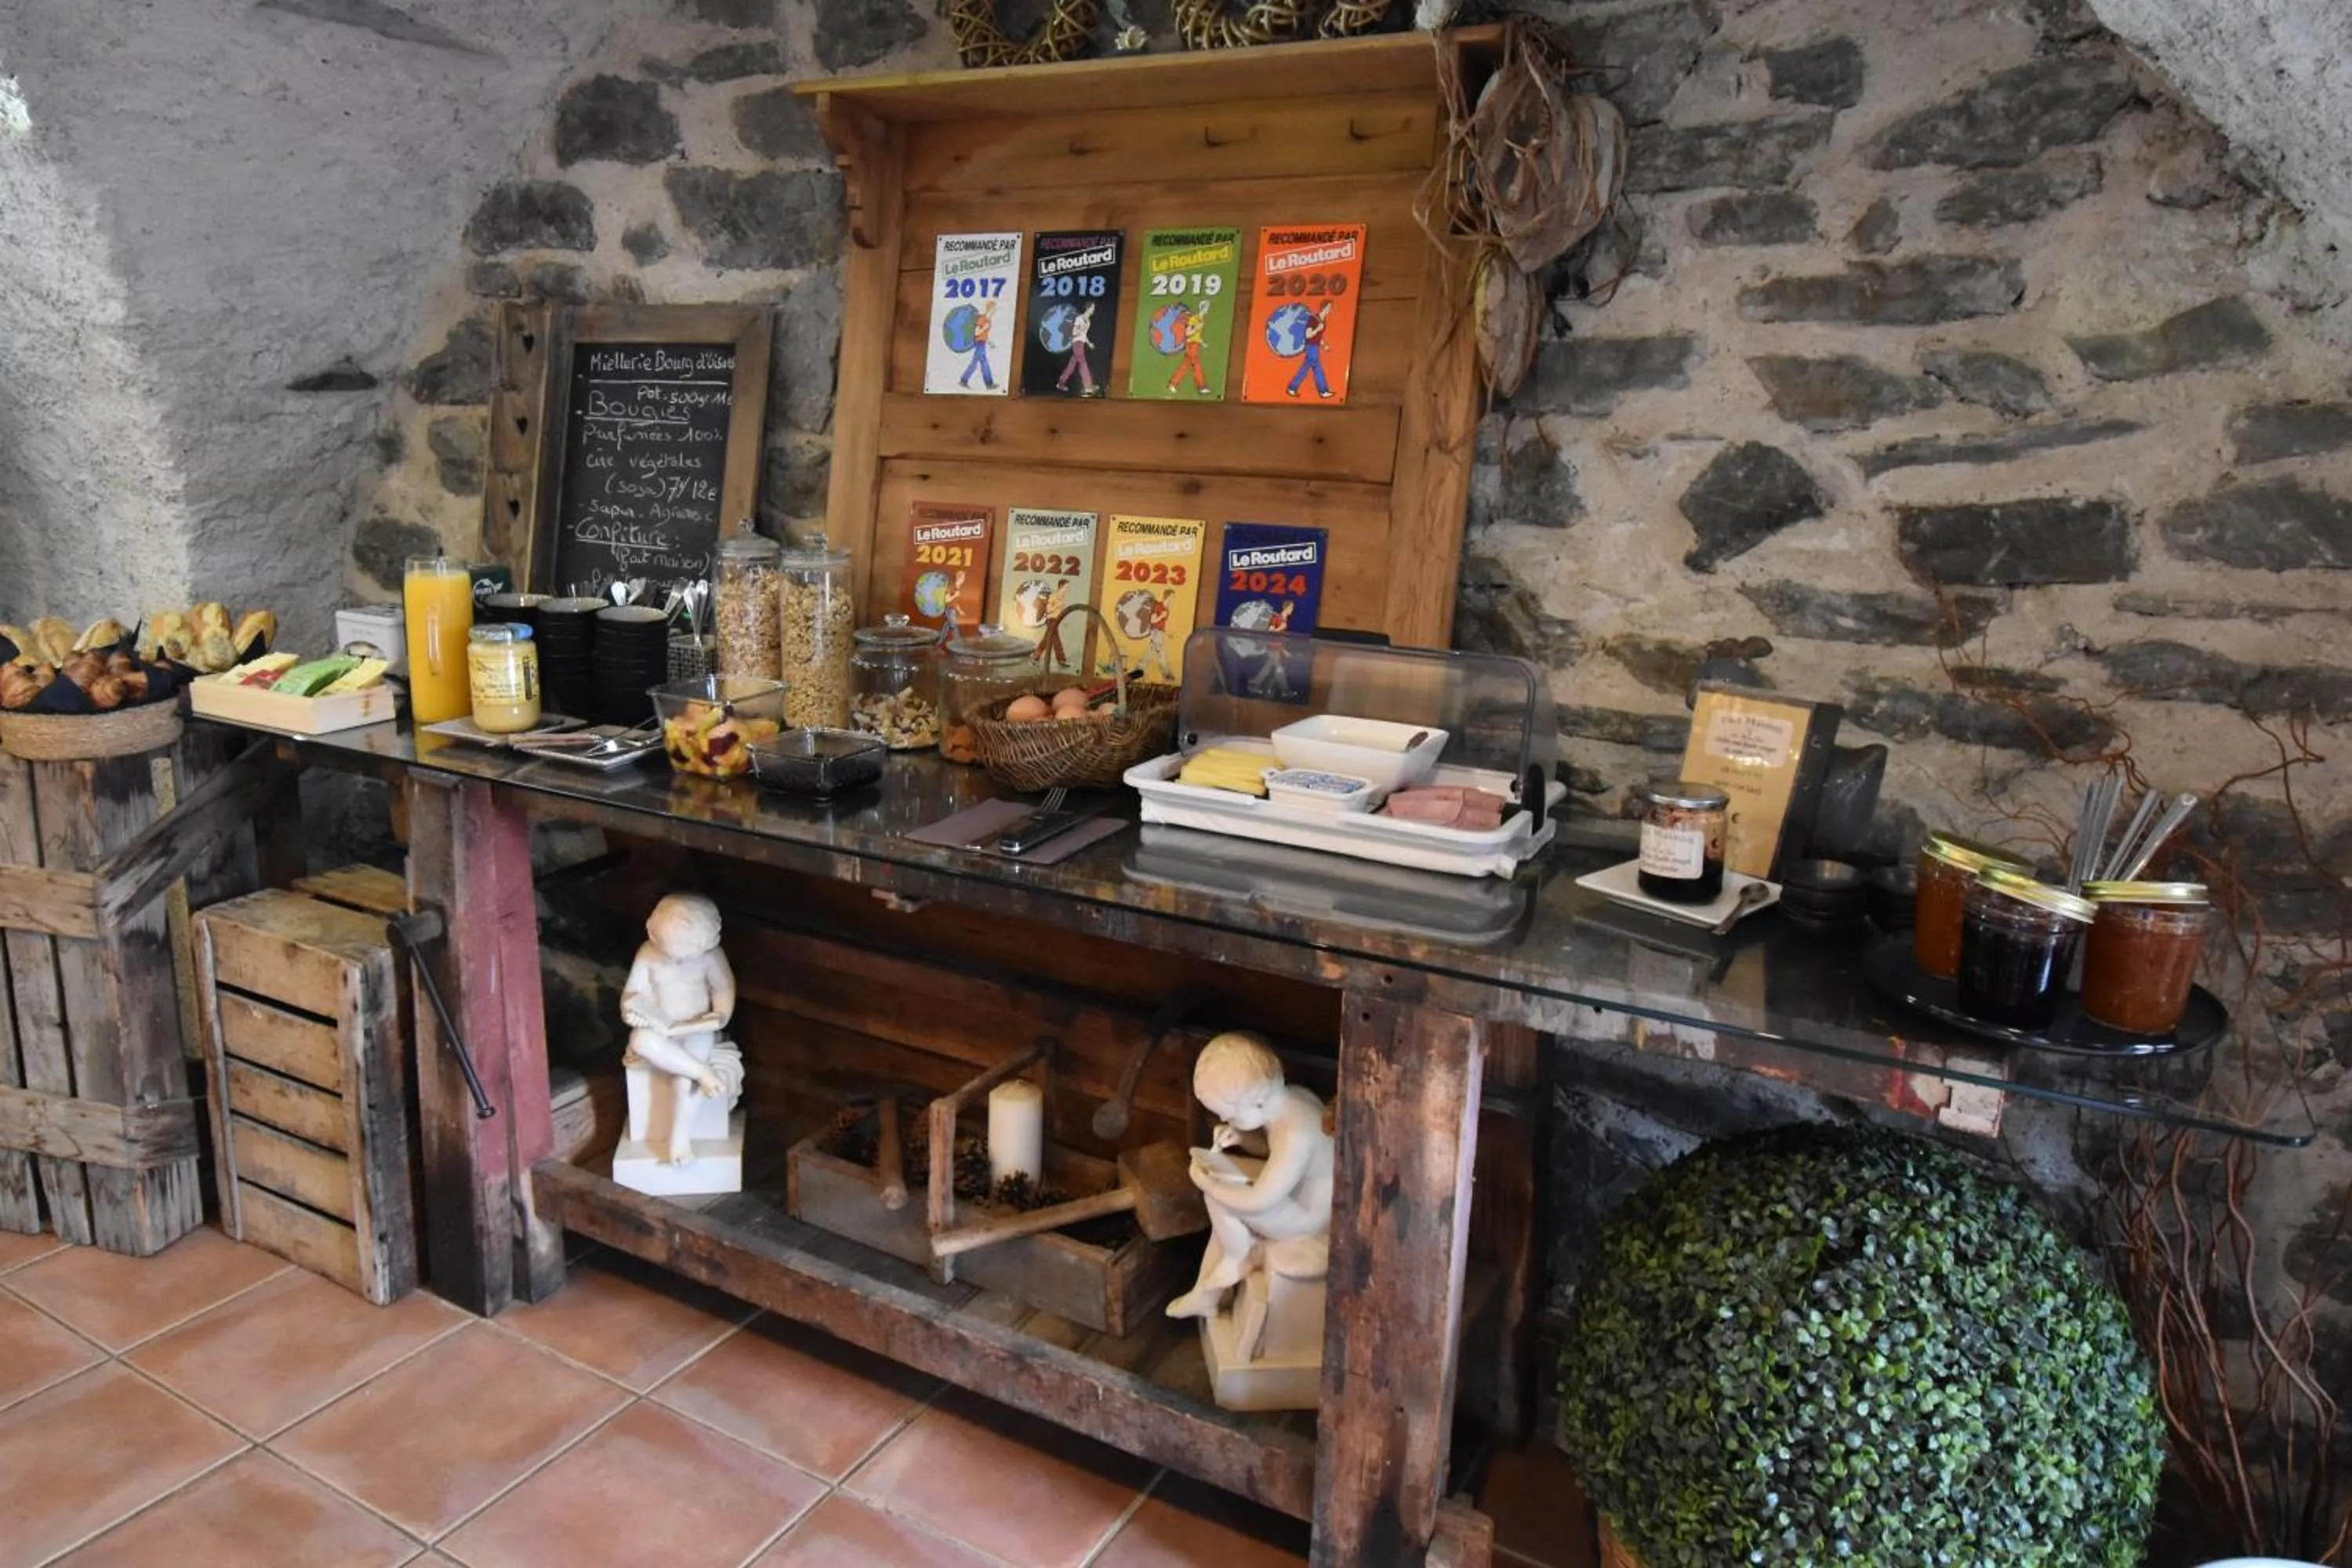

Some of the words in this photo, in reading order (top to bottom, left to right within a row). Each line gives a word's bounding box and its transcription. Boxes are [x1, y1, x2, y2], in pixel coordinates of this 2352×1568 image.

[1000, 238, 1016, 251] PAR
[944, 261, 958, 274] Le
[959, 252, 1011, 271] Routard
[1041, 260, 1055, 274] Le
[1057, 249, 1112, 271] Routard
[1152, 258, 1167, 272] Le
[1169, 246, 1229, 269] Routard
[1269, 255, 1287, 271] Le
[1288, 243, 1352, 267] Routard
[944, 278, 1006, 298] 2017
[1039, 276, 1106, 296] 2018
[1150, 274, 1222, 296] 2019
[1266, 275, 1348, 296] 2020
[590, 351, 652, 372] Miellerie
[589, 390, 690, 426] Bougies
[916, 529, 931, 541] Le
[931, 522, 981, 539] Routard
[1072, 517, 1090, 529] PAR
[1015, 535, 1031, 549] Le
[1032, 528, 1085, 546] Routard
[916, 545, 973, 567] 2021
[1013, 551, 1081, 576] 2022
[1232, 552, 1250, 567] Le
[1251, 546, 1313, 564] Routard
[1114, 560, 1186, 586] 2023
[1229, 570, 1307, 596] 2024
